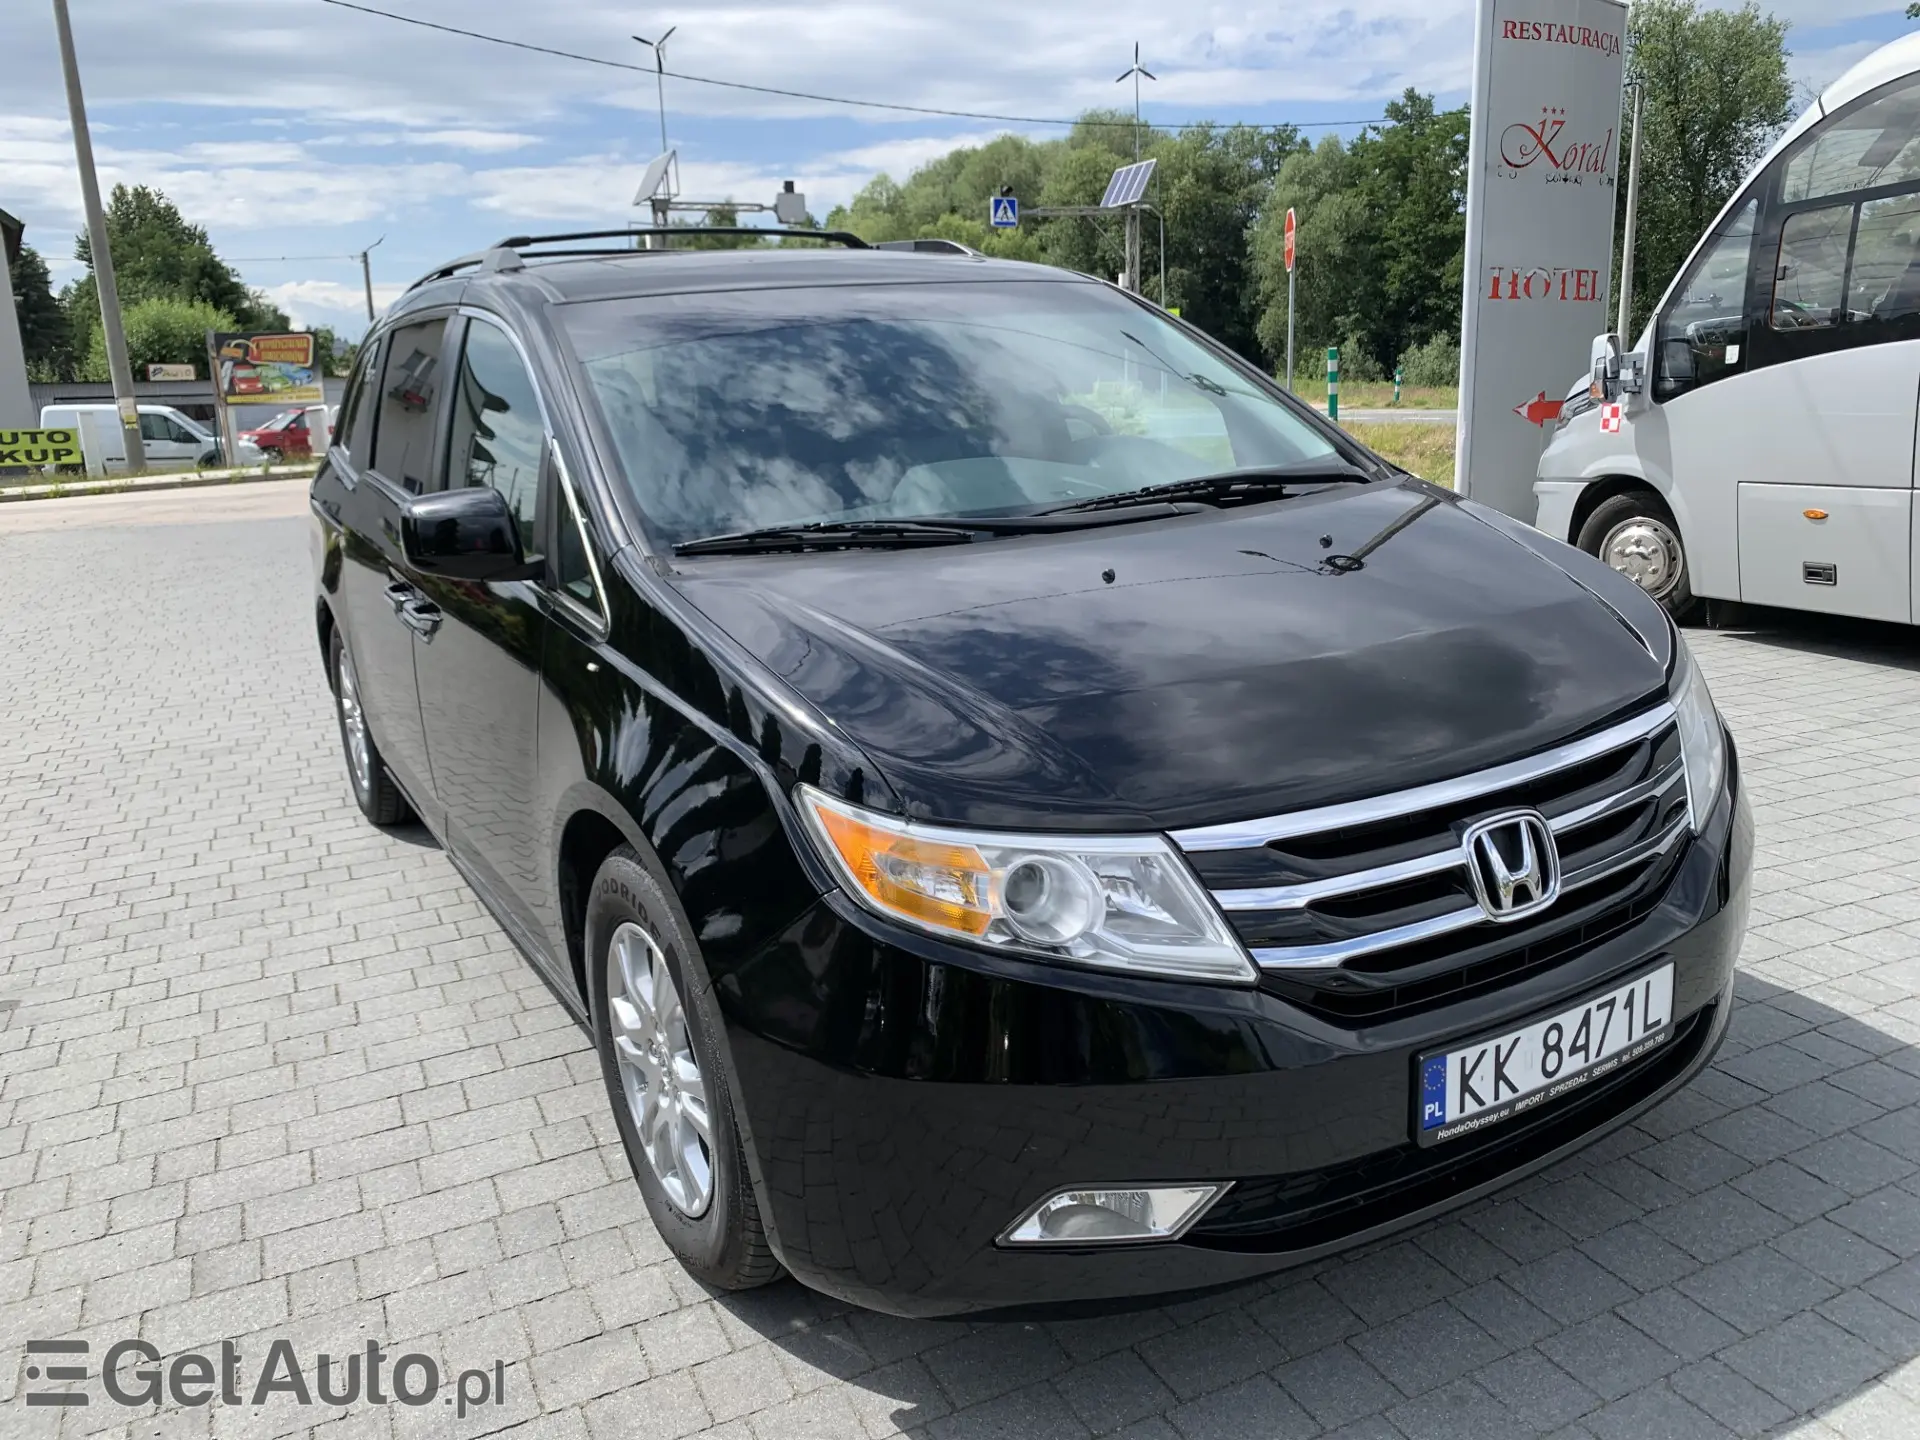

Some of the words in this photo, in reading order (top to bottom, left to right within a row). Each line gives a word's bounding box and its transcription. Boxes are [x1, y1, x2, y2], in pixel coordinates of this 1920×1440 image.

[1502, 20, 1620, 57] RESTAURACJA
[1488, 266, 1603, 302] HOTEL
[1460, 1036, 1521, 1113] KK
[1541, 980, 1662, 1079] 8471L
[1424, 1101, 1443, 1120] PL
[1437, 1108, 1510, 1140] HondaOdyssey.eu
[1515, 1091, 1545, 1111] IMPORT
[1592, 1058, 1618, 1077] SERWIS
